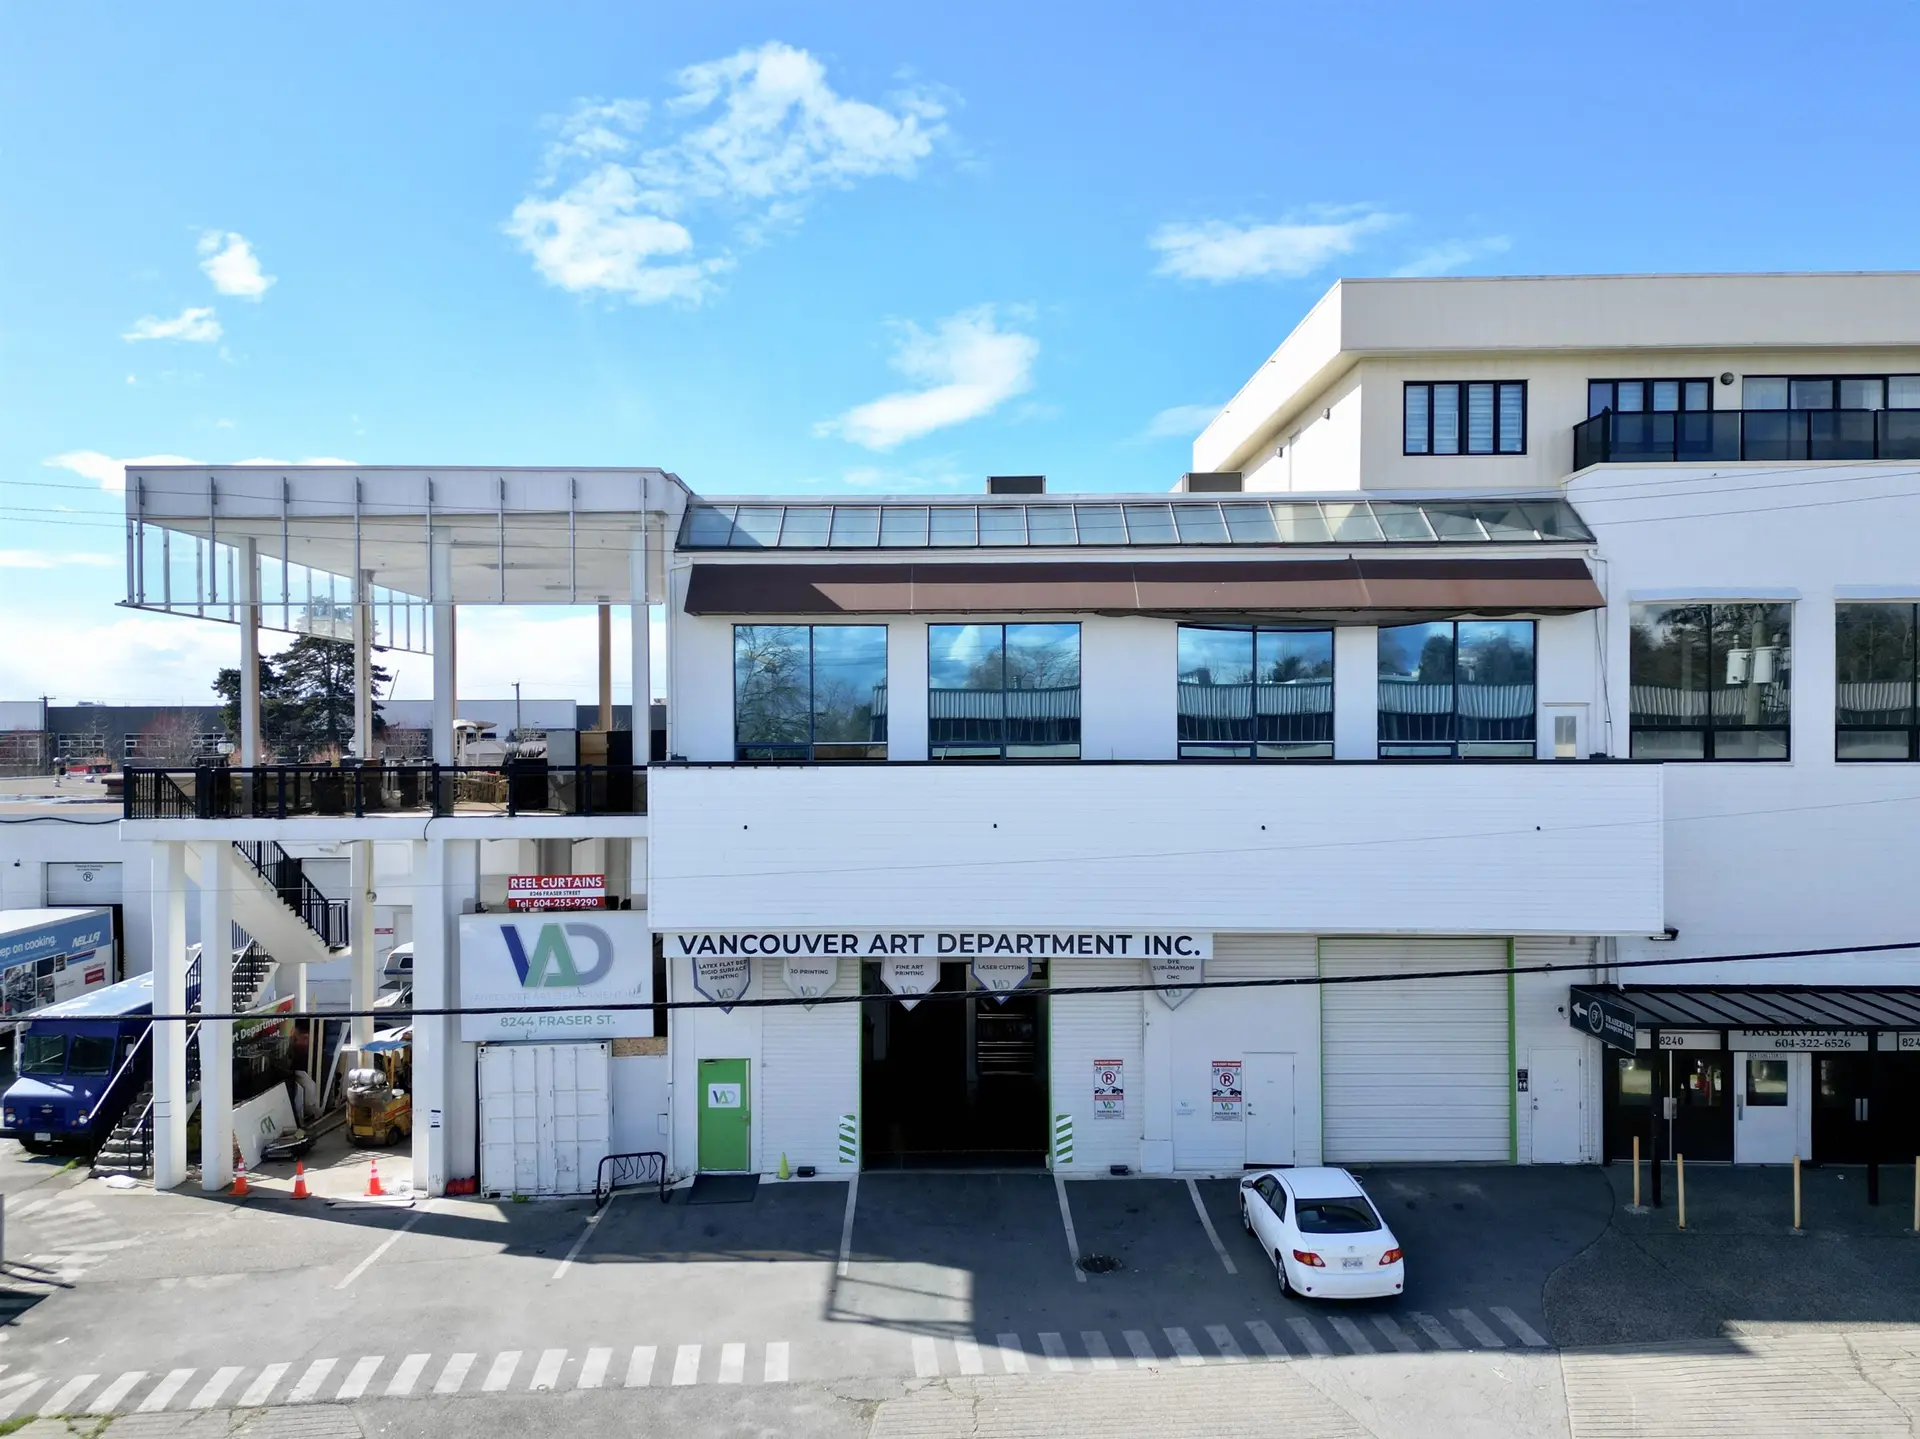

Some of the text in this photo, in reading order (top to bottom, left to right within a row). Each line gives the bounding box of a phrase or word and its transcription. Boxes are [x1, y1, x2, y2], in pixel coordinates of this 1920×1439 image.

[511, 876, 602, 888] REEL CURTAINS
[515, 898, 598, 907] Tel: 604-255-9290
[12, 943, 24, 954] on
[25, 935, 57, 950] cooking.
[72, 931, 101, 948] NELLA
[678, 933, 1200, 956] VANCOUVER ART DEPARTMENT INC.
[719, 965, 747, 973] SURFACE
[710, 973, 739, 981] PRINTING
[500, 1014, 616, 1027] 8244 FRASER ST.
[1659, 1036, 1684, 1046] 8240
[1774, 1038, 1851, 1048] 604-322-6526
